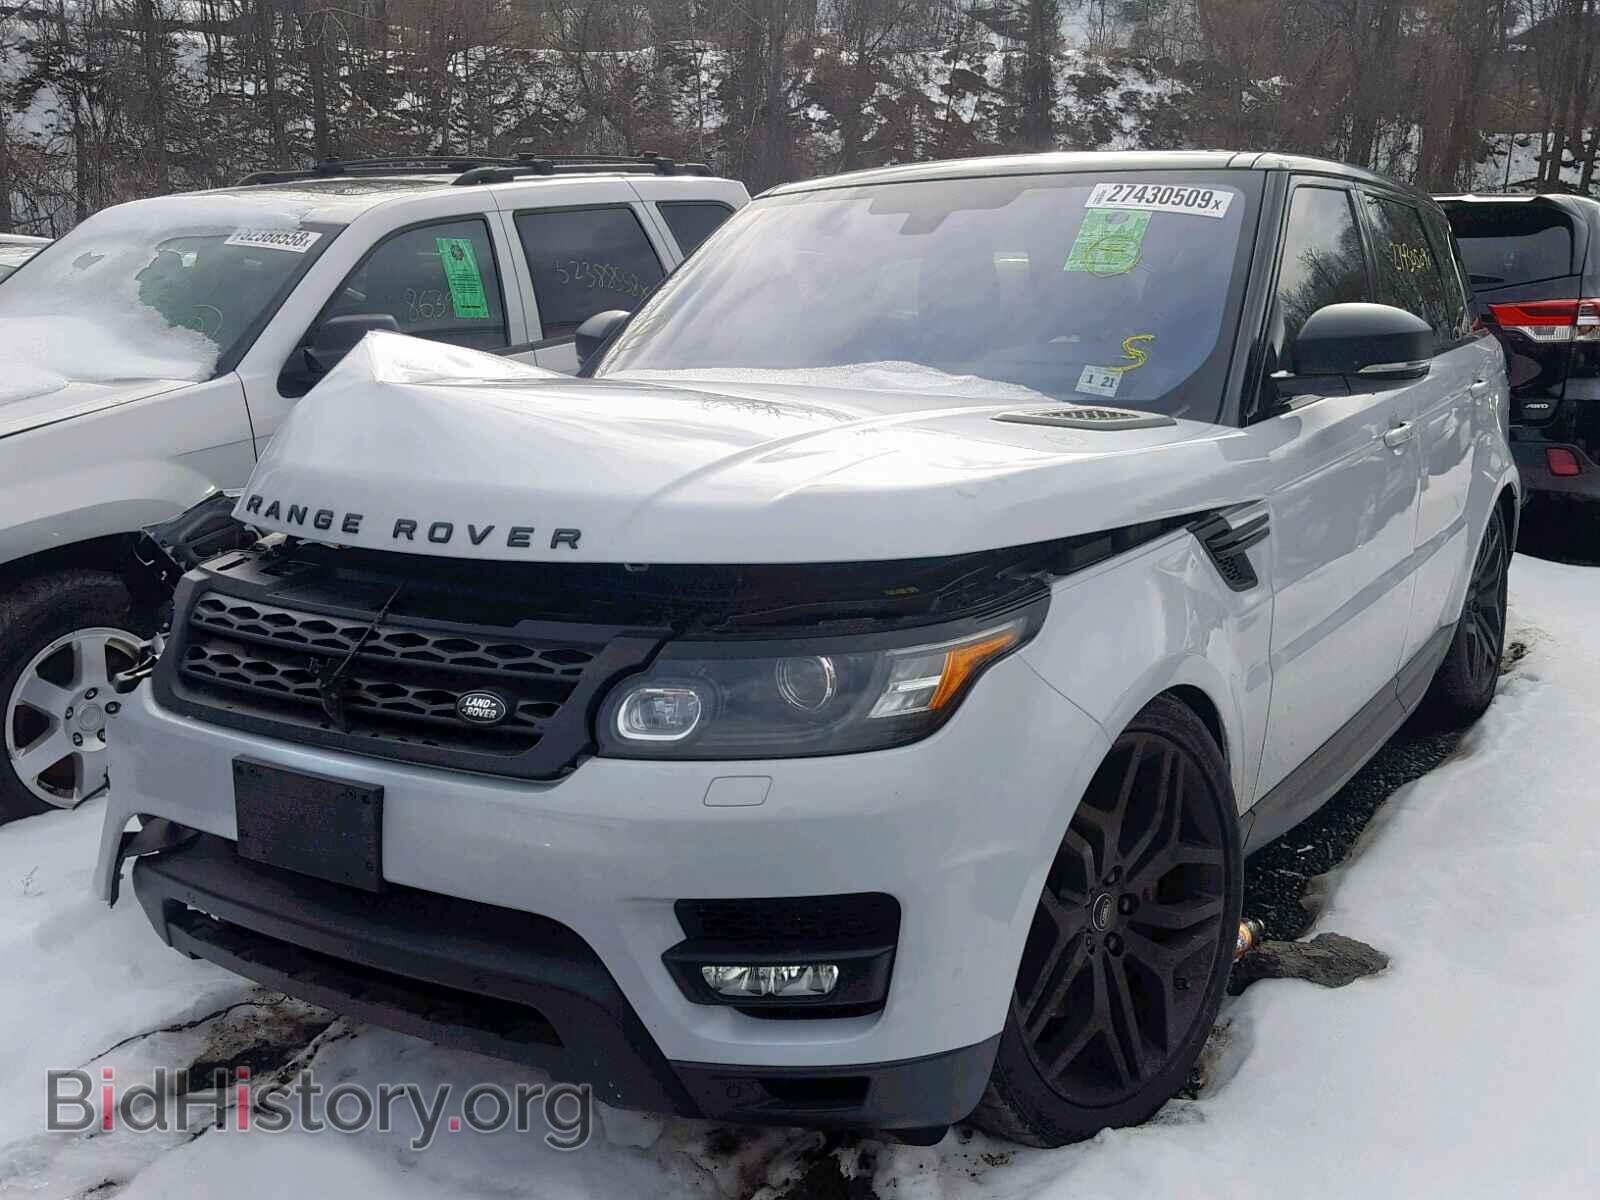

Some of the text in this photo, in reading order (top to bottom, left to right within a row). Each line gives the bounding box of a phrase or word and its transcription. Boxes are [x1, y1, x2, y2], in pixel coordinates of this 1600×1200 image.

[1101, 375, 1115, 389] 21
[246, 494, 582, 550] RANGE ROVER
